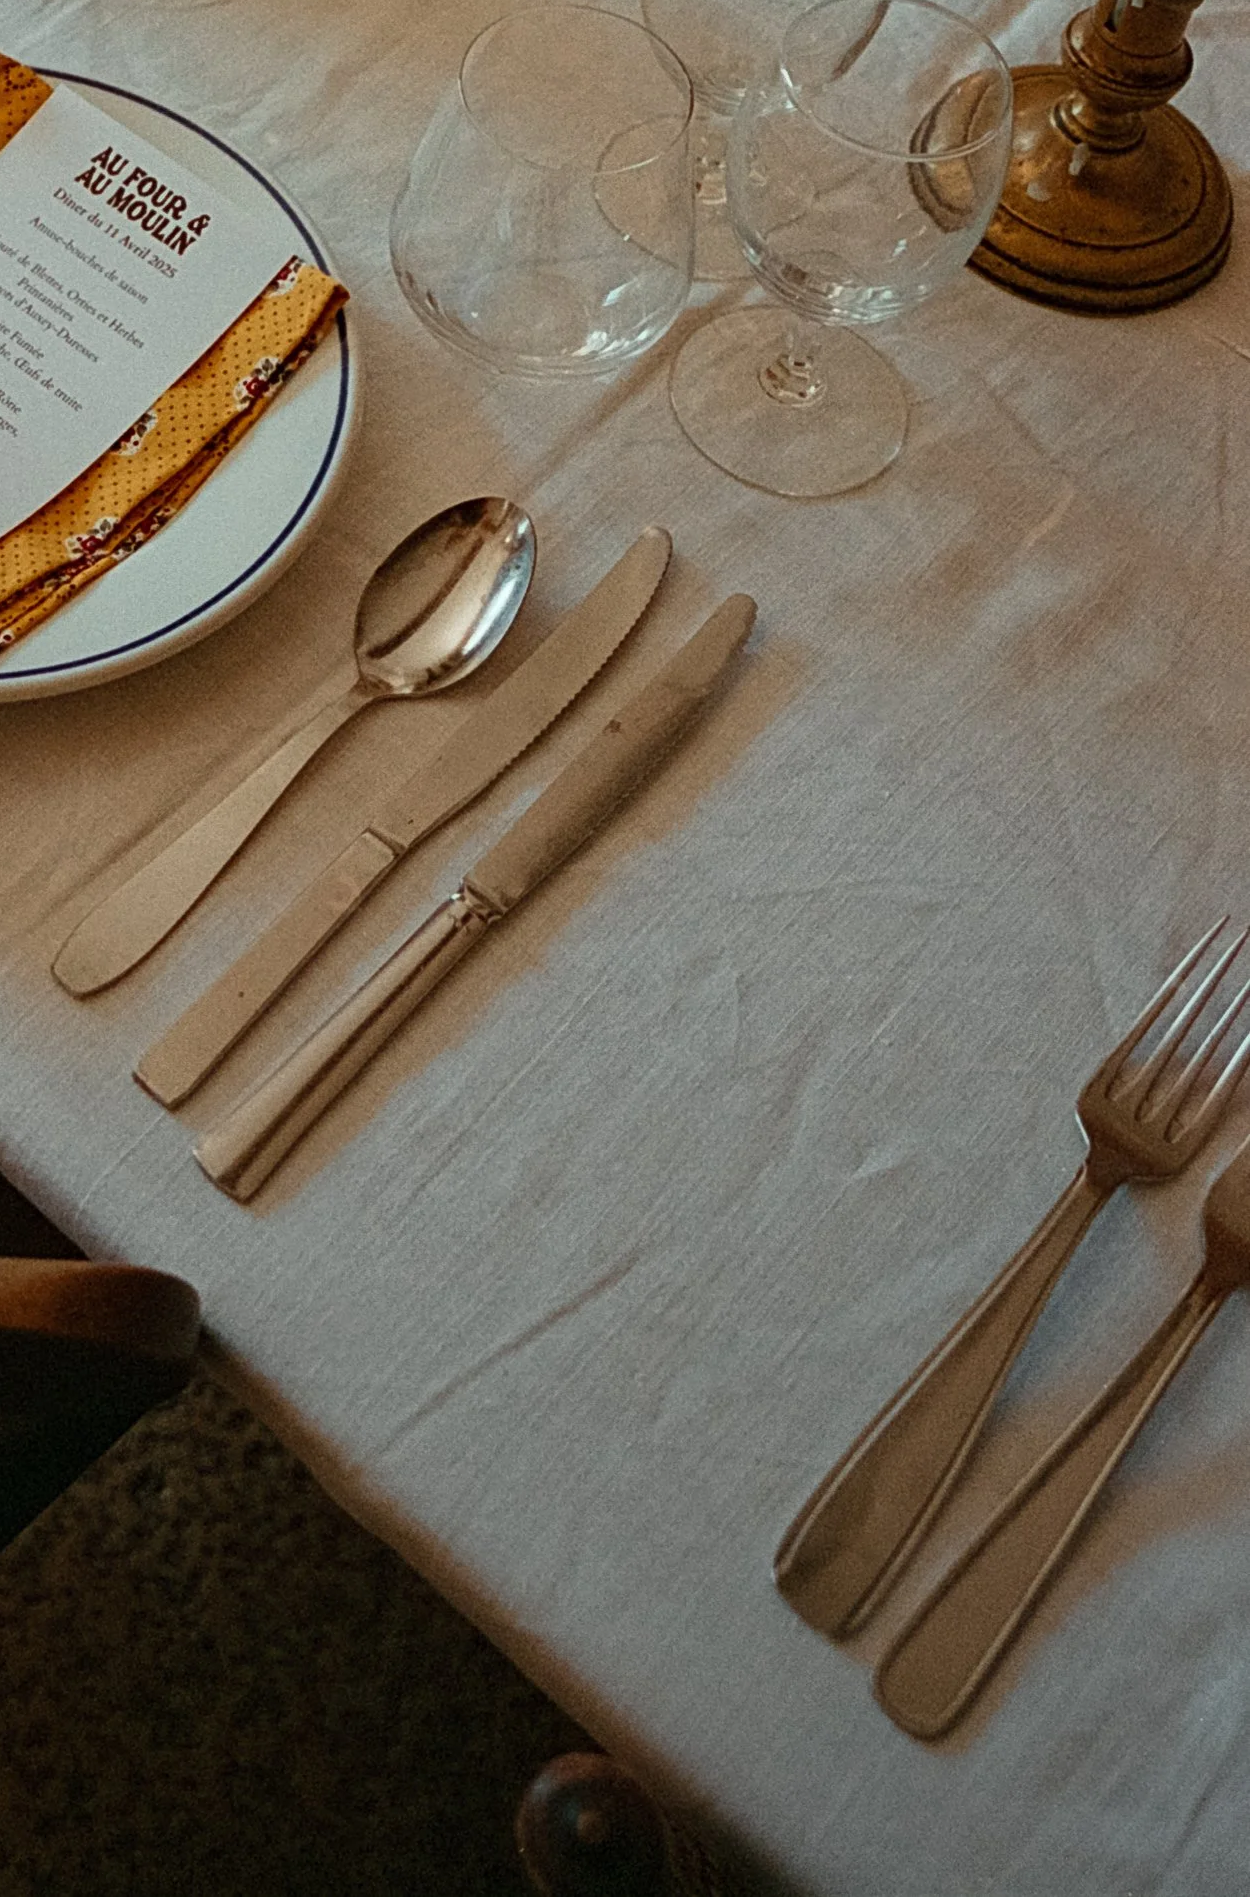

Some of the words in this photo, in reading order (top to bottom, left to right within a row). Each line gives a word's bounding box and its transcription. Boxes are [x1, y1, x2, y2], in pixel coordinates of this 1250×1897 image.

[74, 165, 113, 196] AU
[106, 186, 197, 256] MOULIN
[90, 146, 130, 177] AU
[122, 166, 188, 221] FOUR
[186, 214, 211, 237] &
[86, 212, 104, 229] du
[103, 223, 120, 239] 11
[118, 234, 152, 260] Avril
[146, 254, 178, 279] 2025
[103, 269, 119, 283] de
[16, 254, 31, 268] de
[96, 313, 110, 324] et
[107, 318, 145, 350] Herbes
[9, 330, 45, 360] Fumée
[39, 377, 55, 390] de
[53, 387, 83, 412] truite
